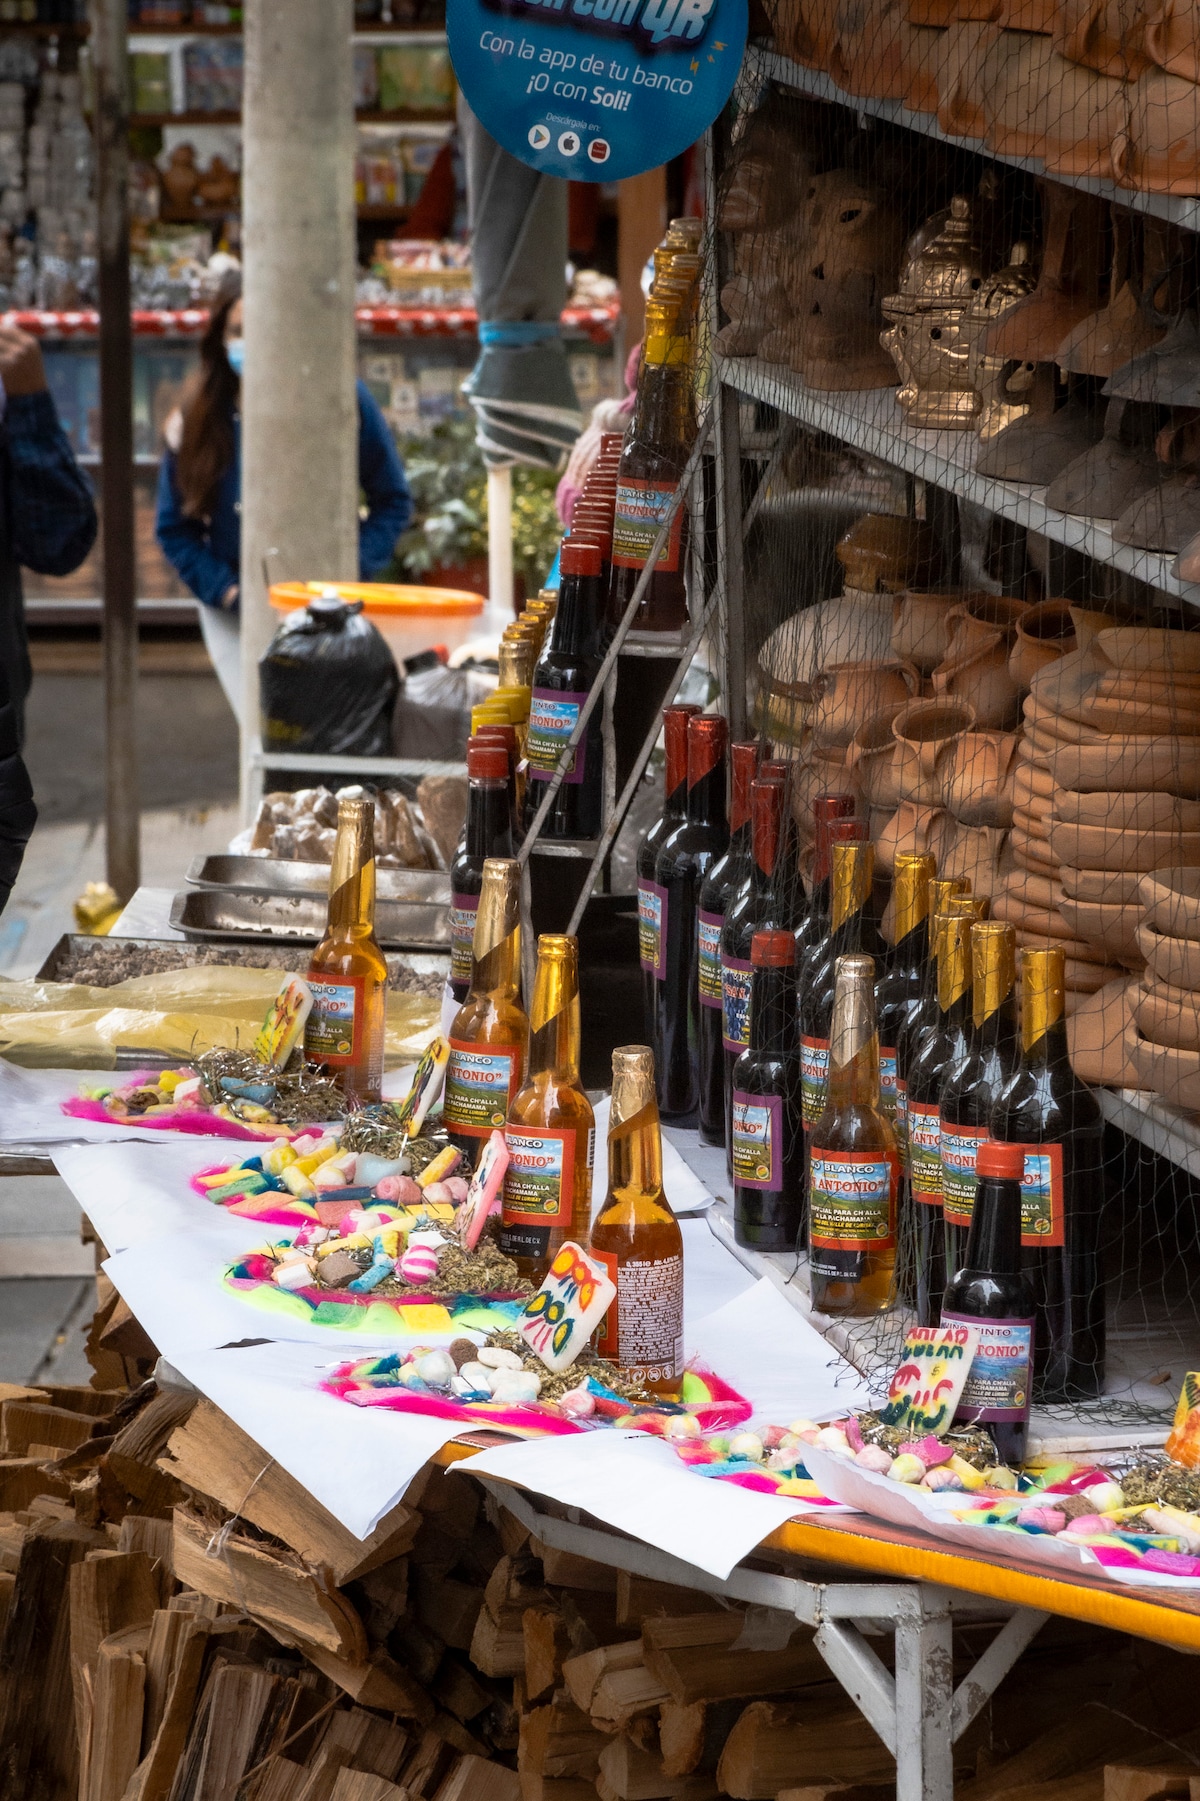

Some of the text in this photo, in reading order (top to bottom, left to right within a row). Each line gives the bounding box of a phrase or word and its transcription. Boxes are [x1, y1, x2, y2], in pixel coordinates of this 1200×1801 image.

[480, 31, 693, 95] Con la app de tu banco
[526, 73, 632, 112] ¡O con Soli!
[451, 1051, 492, 1065] BLANCO
[470, 1097, 498, 1106] CH'ALLA
[824, 1162, 875, 1174] BLANCO
[522, 1183, 550, 1191] CH'ALLA
[977, 1344, 1025, 1358] TONIO”
